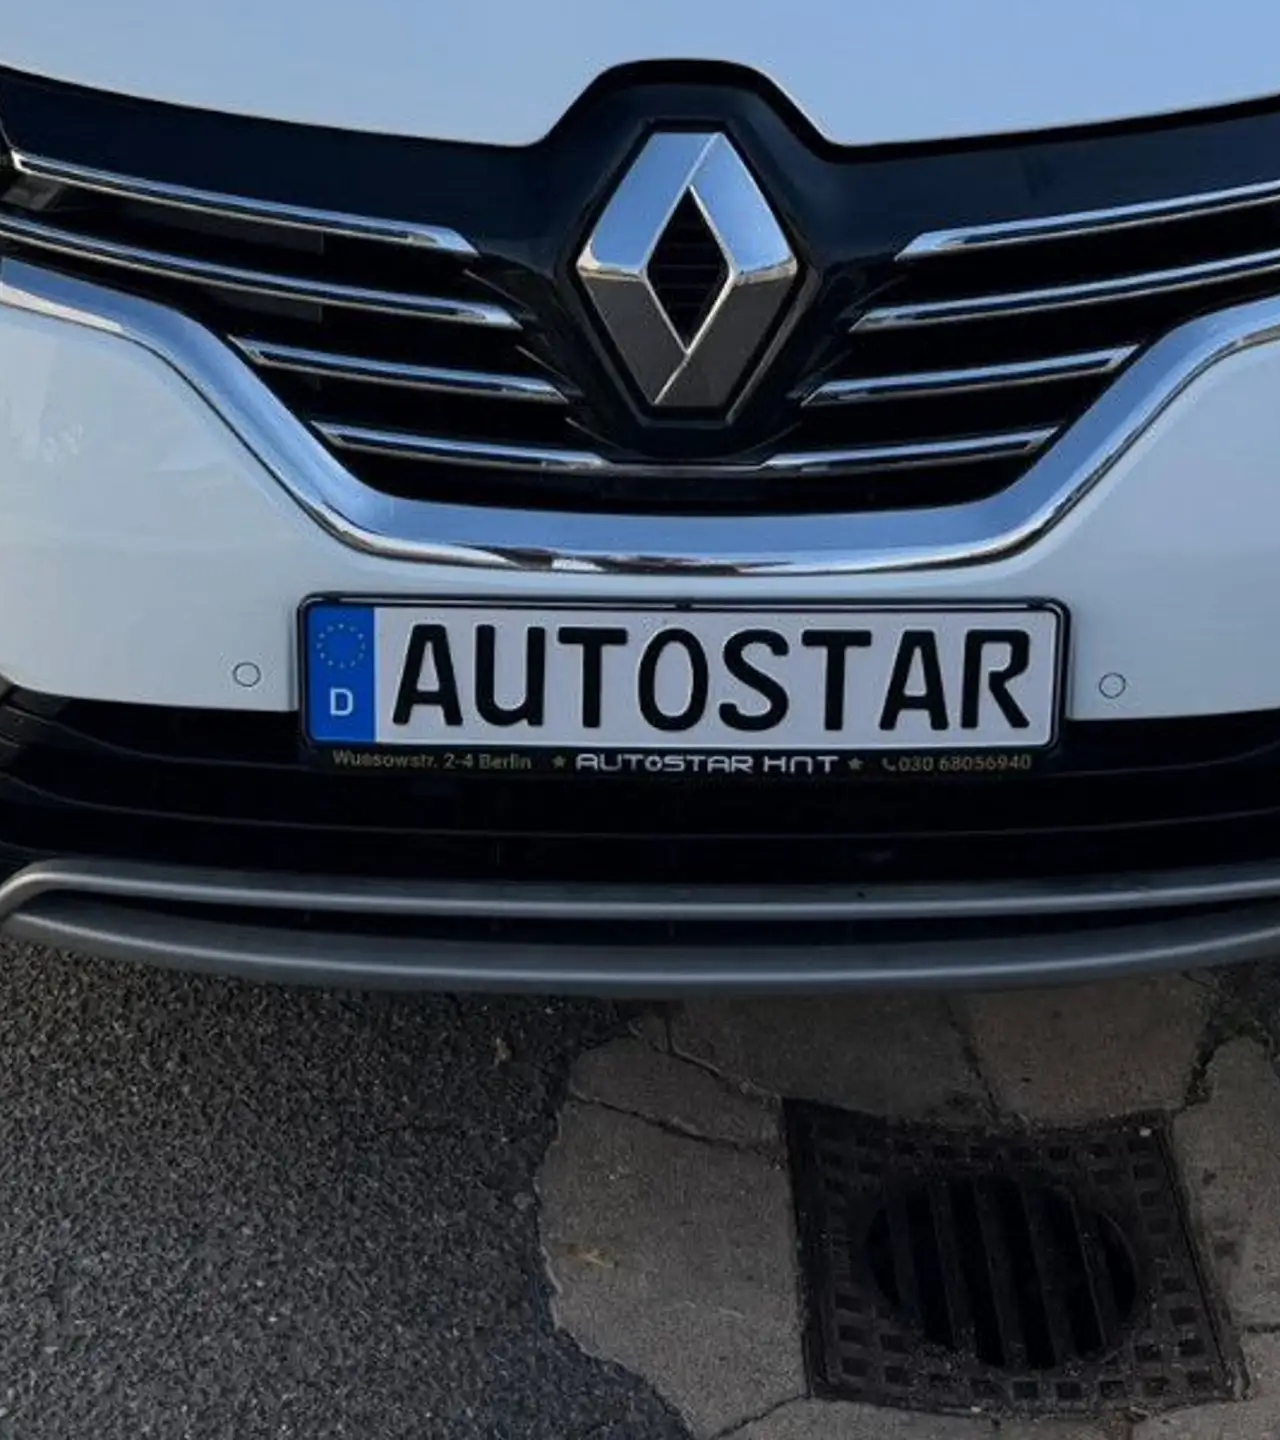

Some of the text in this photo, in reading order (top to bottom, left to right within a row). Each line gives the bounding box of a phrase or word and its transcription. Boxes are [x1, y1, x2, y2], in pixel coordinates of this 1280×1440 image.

[391, 624, 1031, 732] AUTOSTAR
[330, 687, 354, 716] D
[443, 751, 474, 770] 2-4
[478, 752, 532, 770] Berlin
[575, 753, 754, 773] AUTOSTAR
